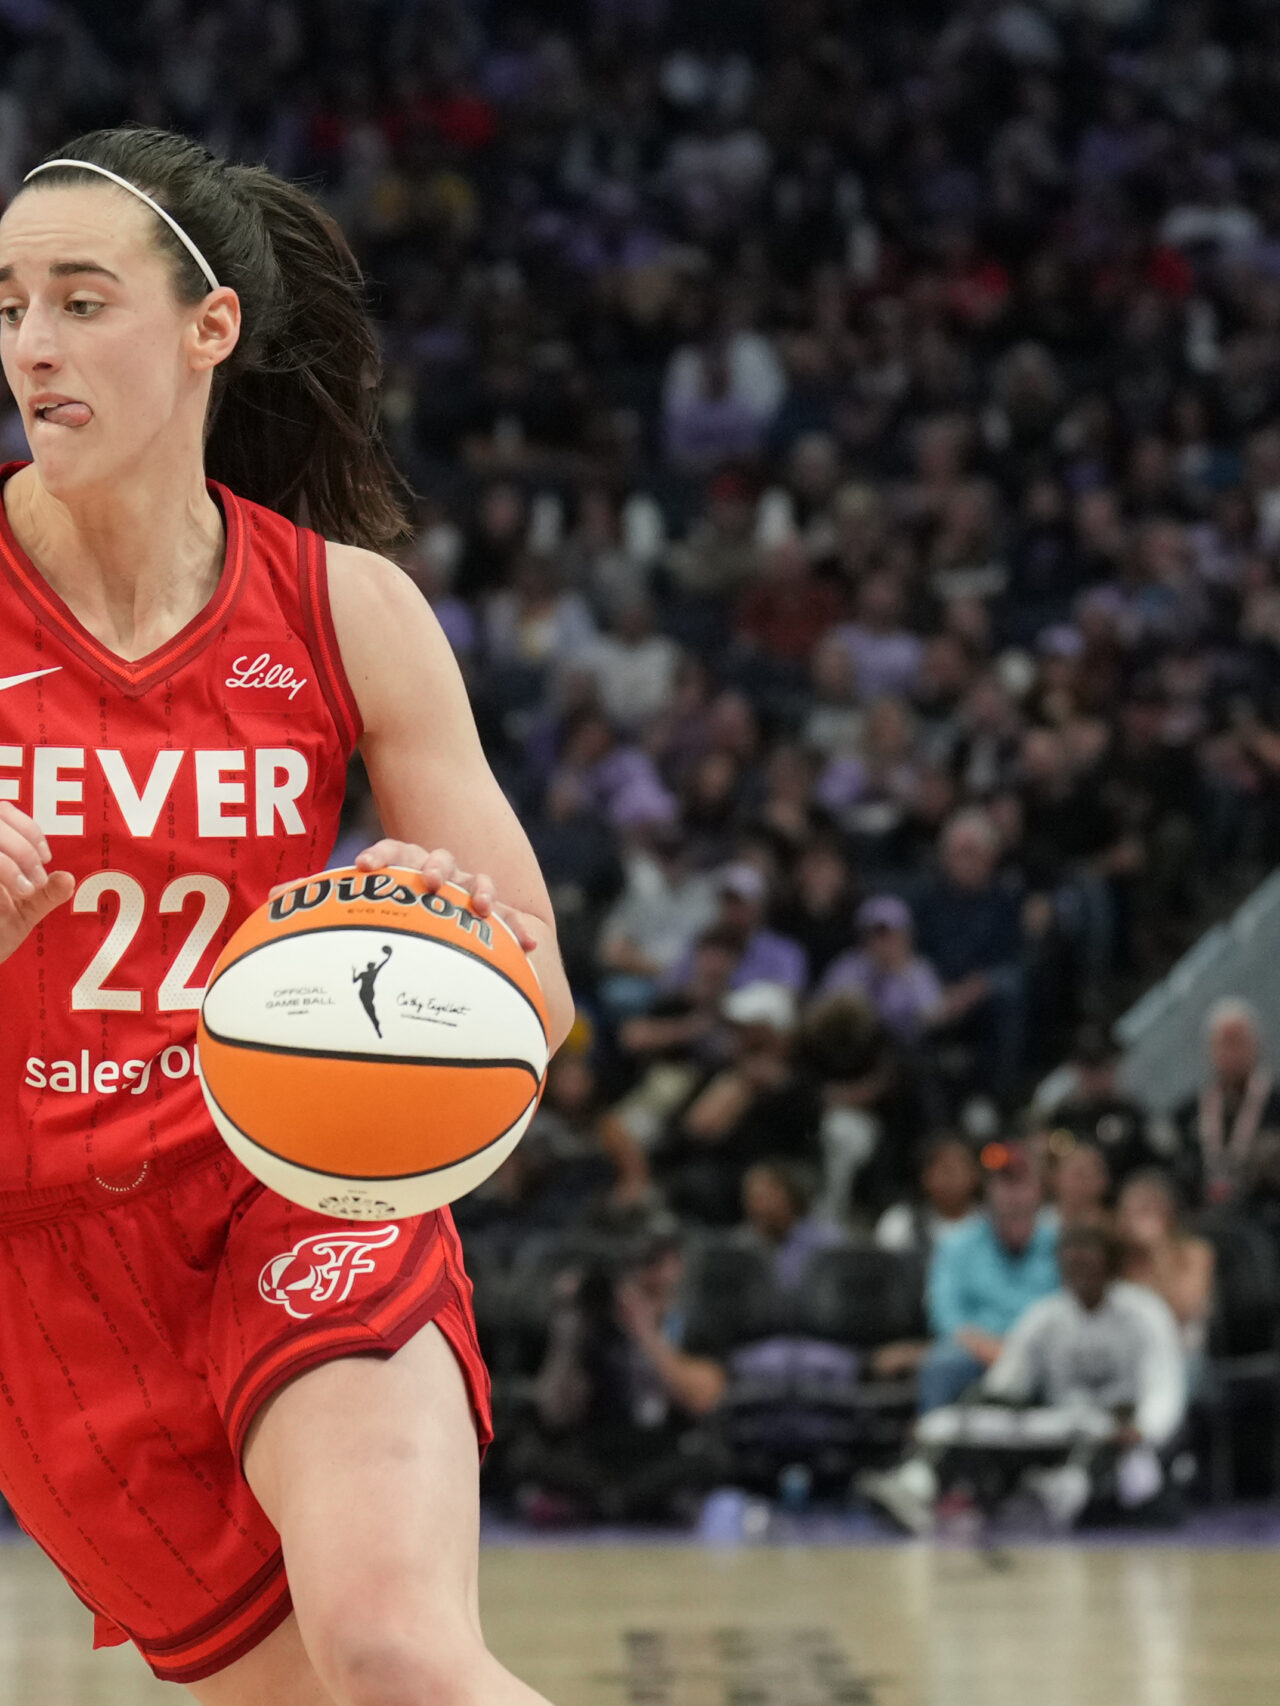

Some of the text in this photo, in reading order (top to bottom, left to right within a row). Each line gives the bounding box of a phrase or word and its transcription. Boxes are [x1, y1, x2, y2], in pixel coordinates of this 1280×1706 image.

[225, 653, 307, 700] Lilly
[269, 873, 494, 950] Wilson
[71, 871, 231, 1013] 22
[265, 996, 336, 1009] GAME BALL
[273, 986, 328, 998] OFFICIAL
